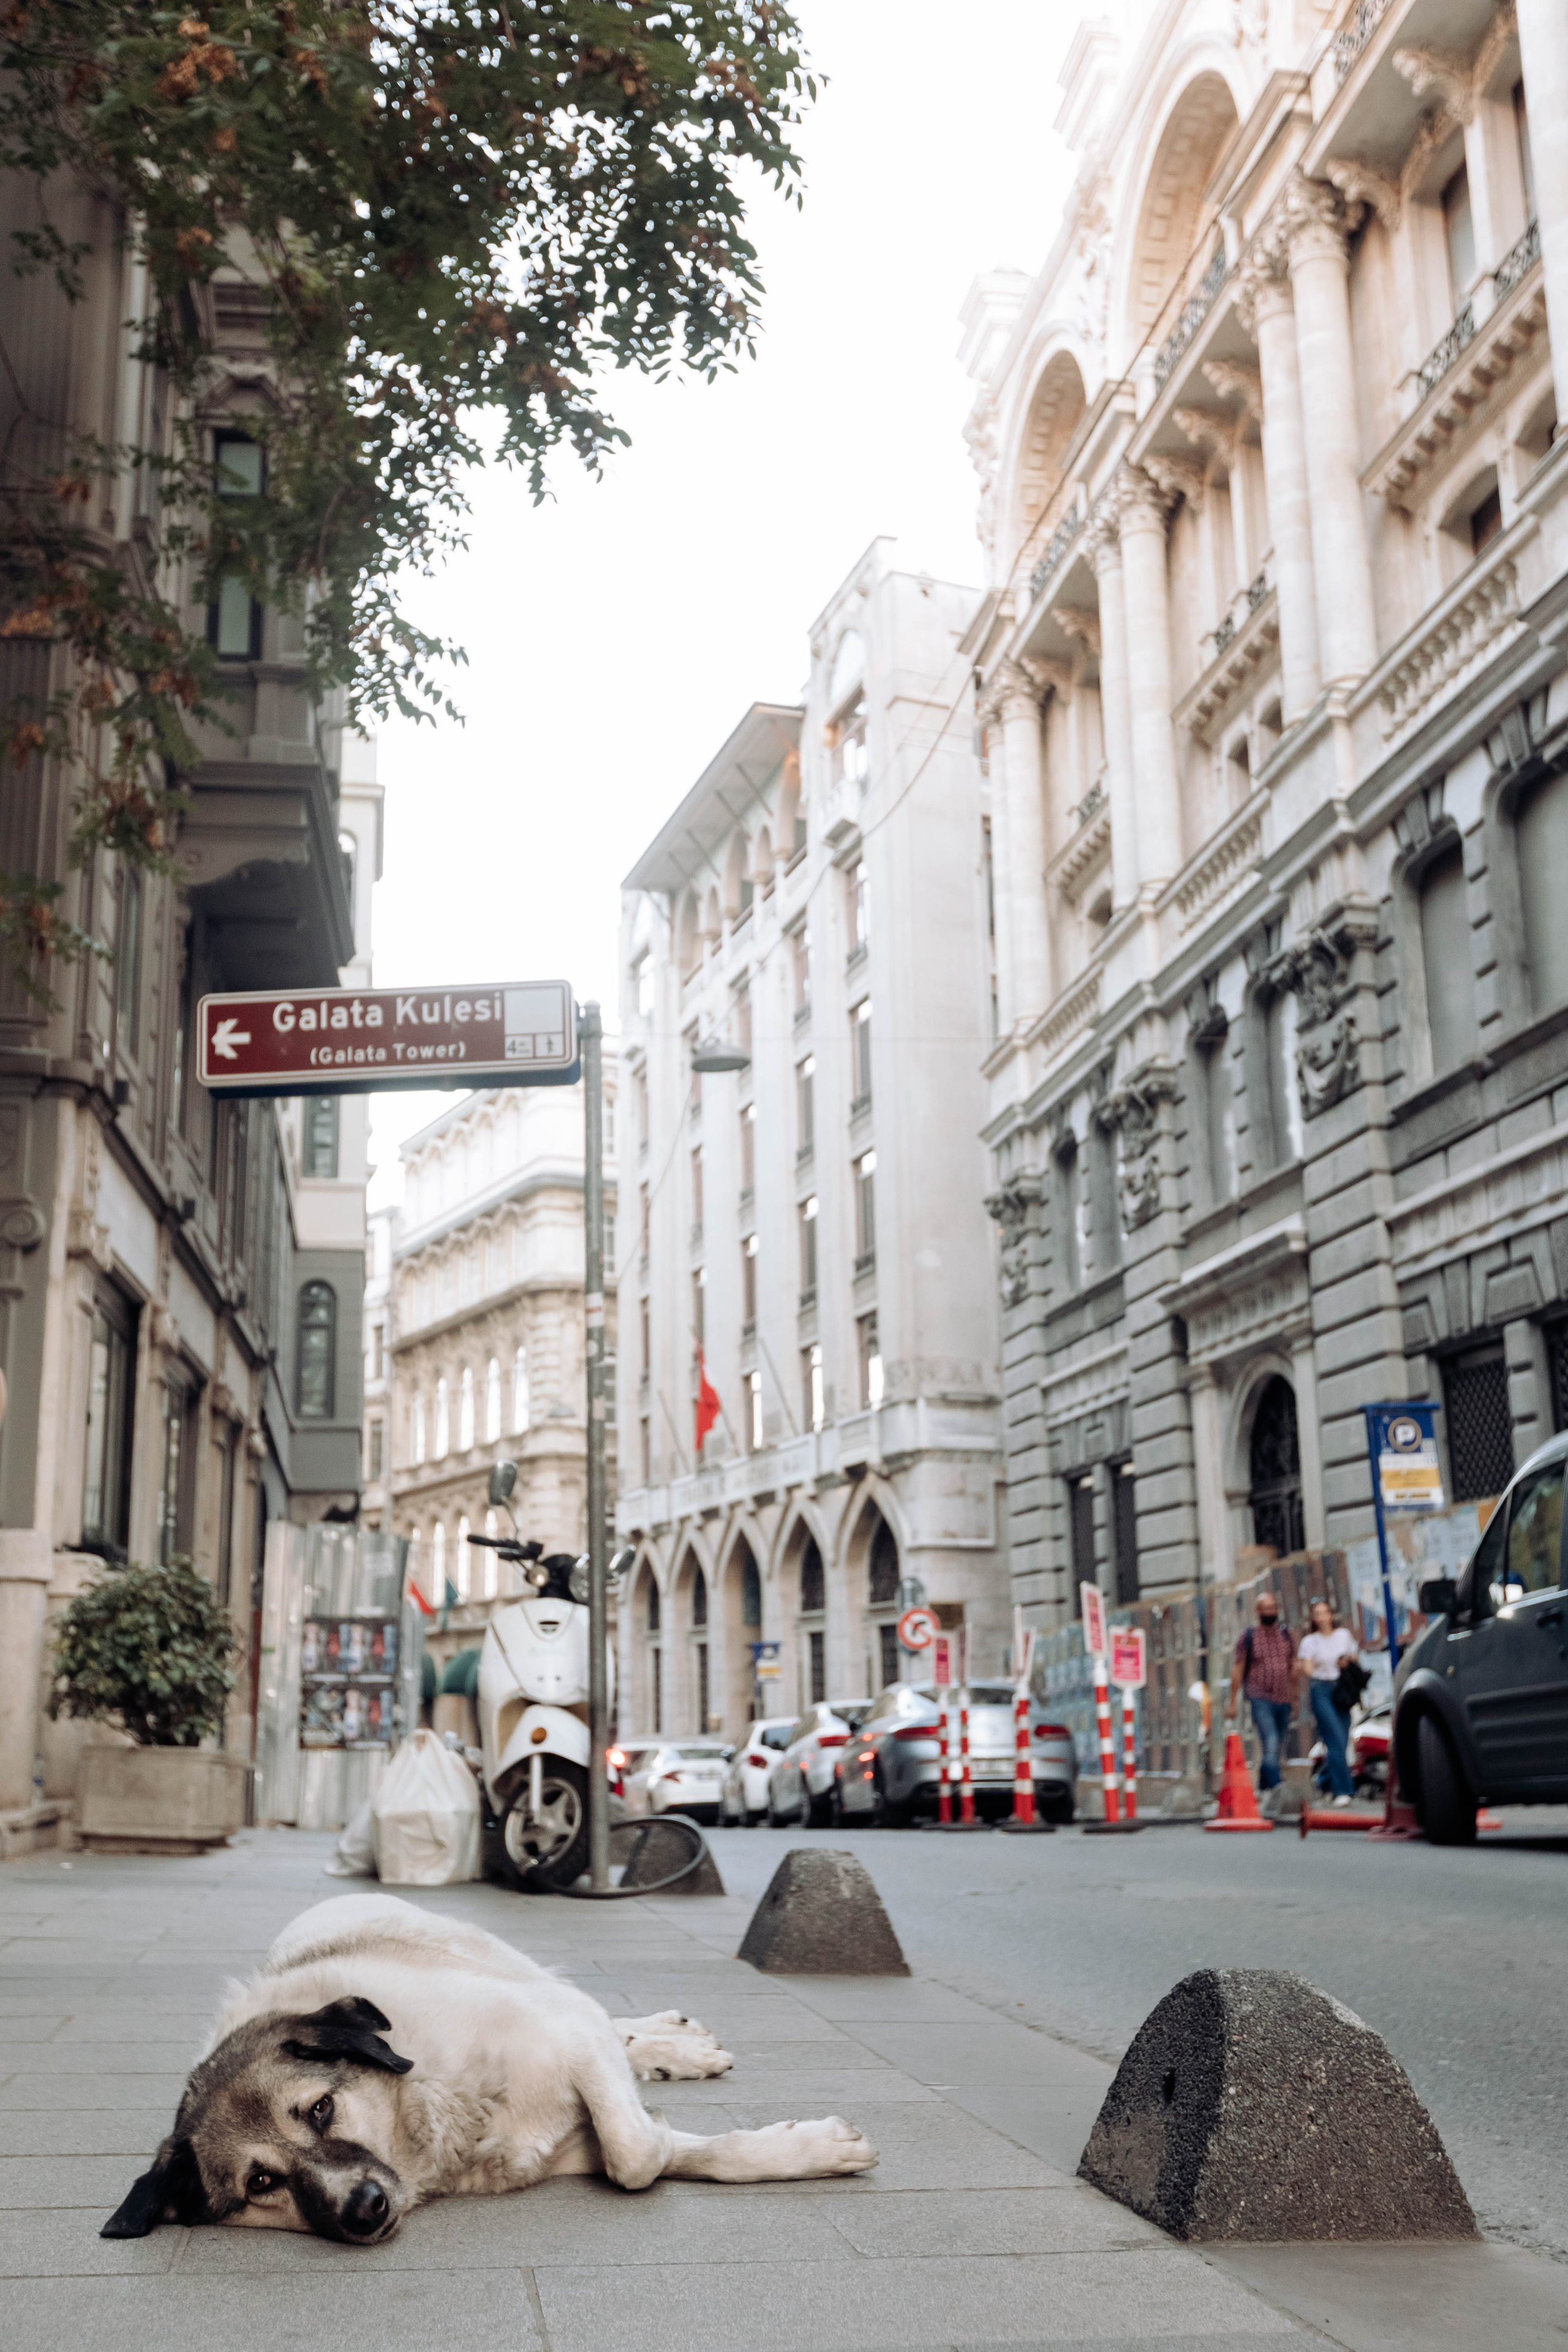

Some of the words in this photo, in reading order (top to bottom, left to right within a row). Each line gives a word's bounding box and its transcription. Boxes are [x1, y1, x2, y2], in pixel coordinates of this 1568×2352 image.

[273, 999, 383, 1033] Galata
[396, 992, 502, 1025] Kulesi
[310, 1044, 387, 1065] (Galata
[393, 1041, 466, 1061] Tower)
